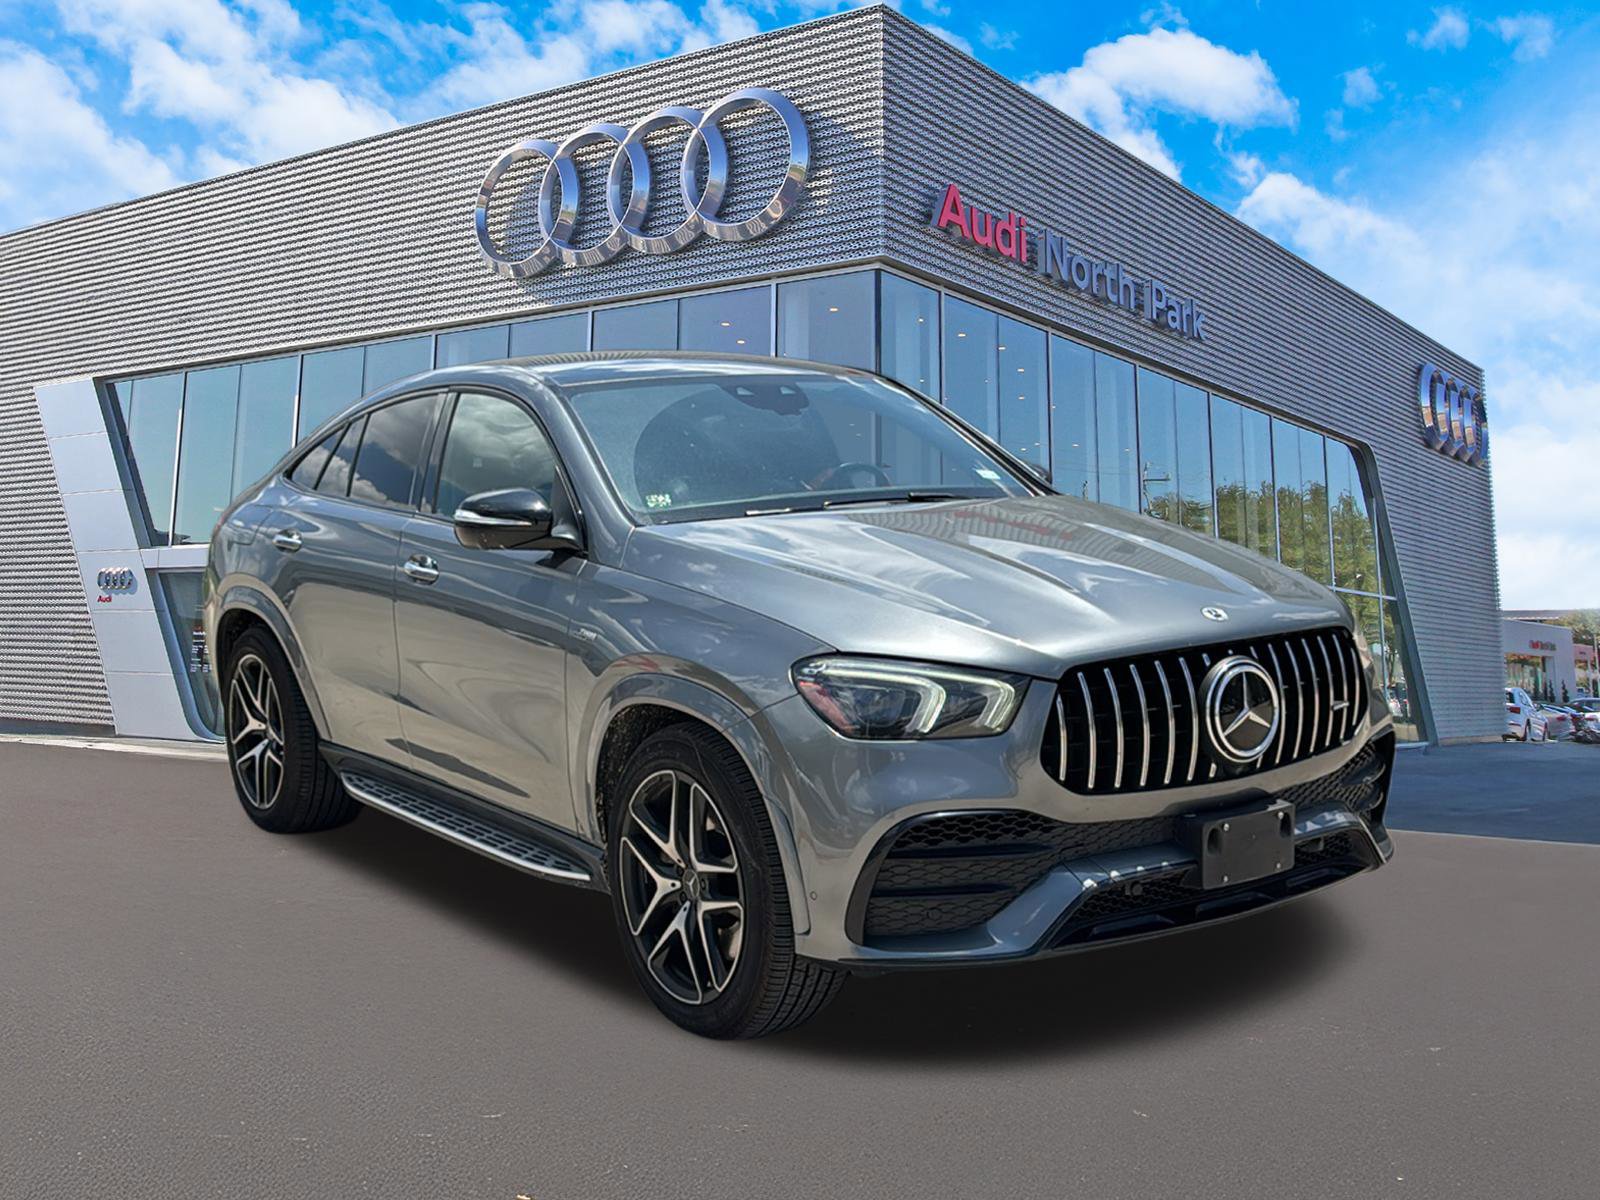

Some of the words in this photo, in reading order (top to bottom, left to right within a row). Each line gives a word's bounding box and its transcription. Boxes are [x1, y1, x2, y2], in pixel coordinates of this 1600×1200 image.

[932, 183, 1028, 265] Audi
[1038, 229, 1138, 312] North
[1145, 278, 1208, 342] Park
